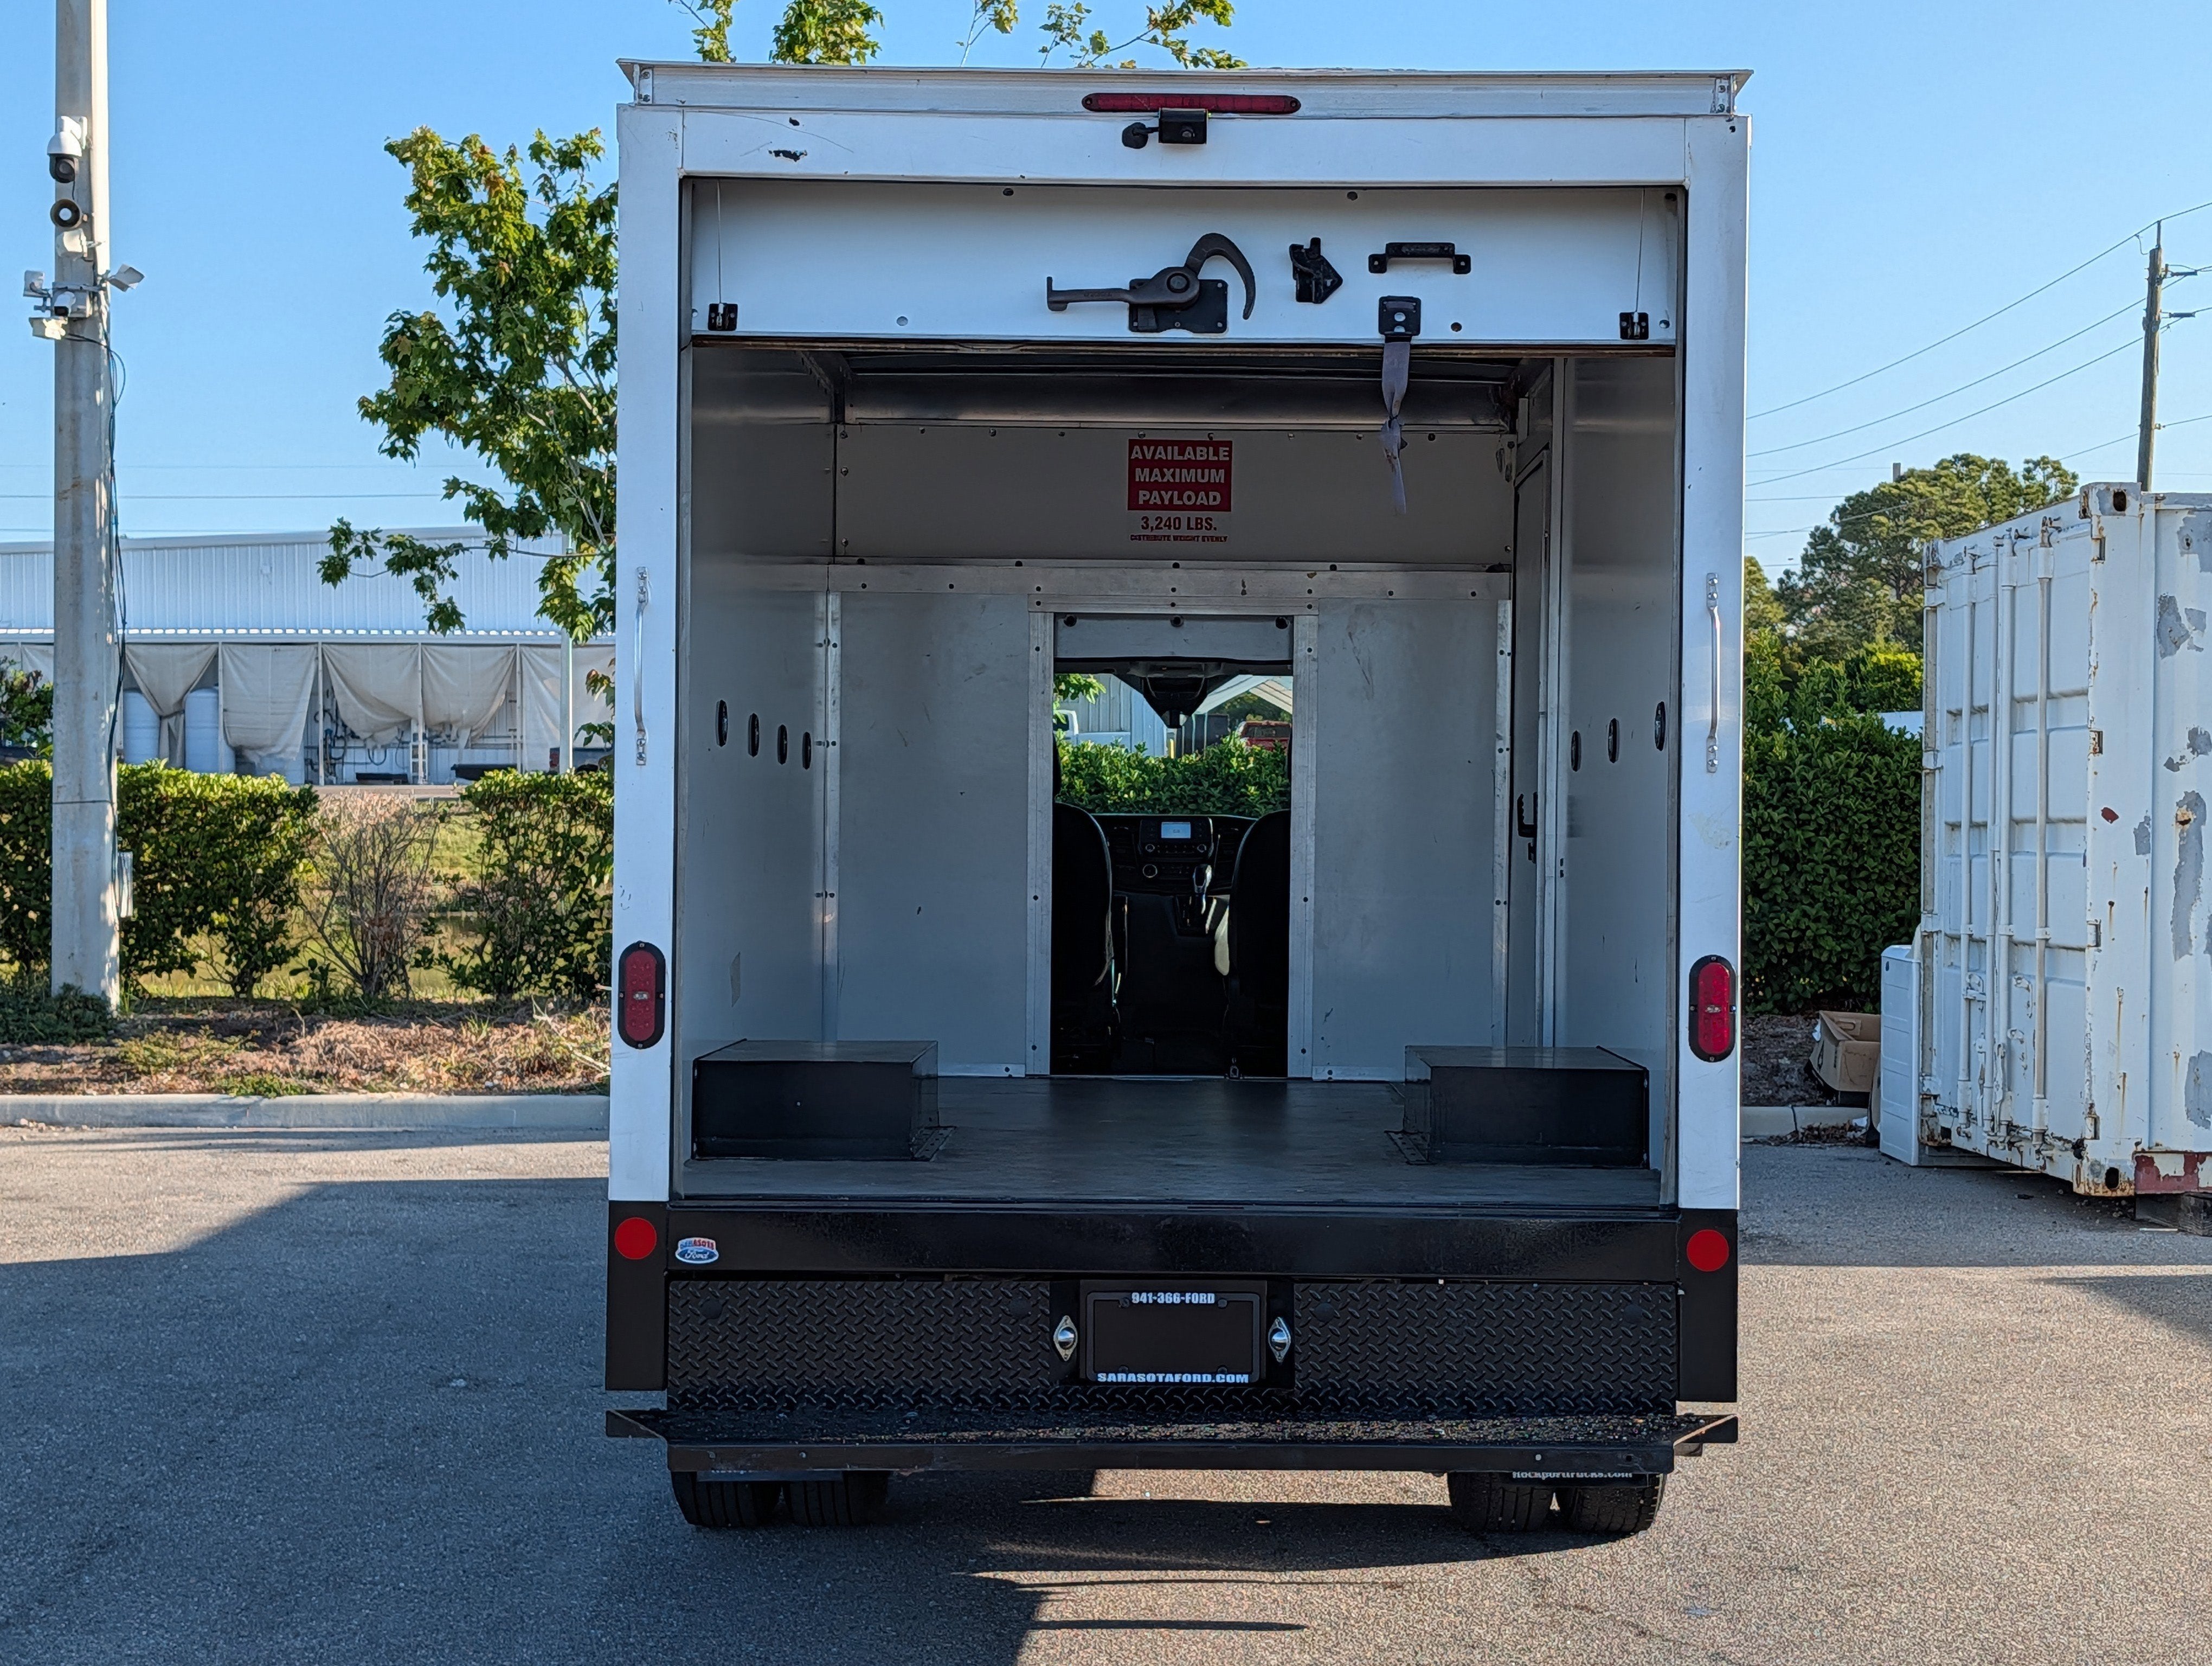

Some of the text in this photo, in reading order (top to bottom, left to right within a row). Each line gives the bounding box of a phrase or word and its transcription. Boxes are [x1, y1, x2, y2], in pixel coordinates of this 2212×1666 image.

[1130, 445, 1229, 460] AVAILABLE
[1135, 468, 1225, 483] MAXIMUM
[1139, 490, 1221, 505] PAYLOAD
[1141, 516, 1217, 532] 3,240 LBS.
[685, 1248, 709, 1259] Ford
[1131, 1292, 1216, 1304] 941-366-FORD
[1097, 1373, 1249, 1383] SARASOTAFORD.COM
